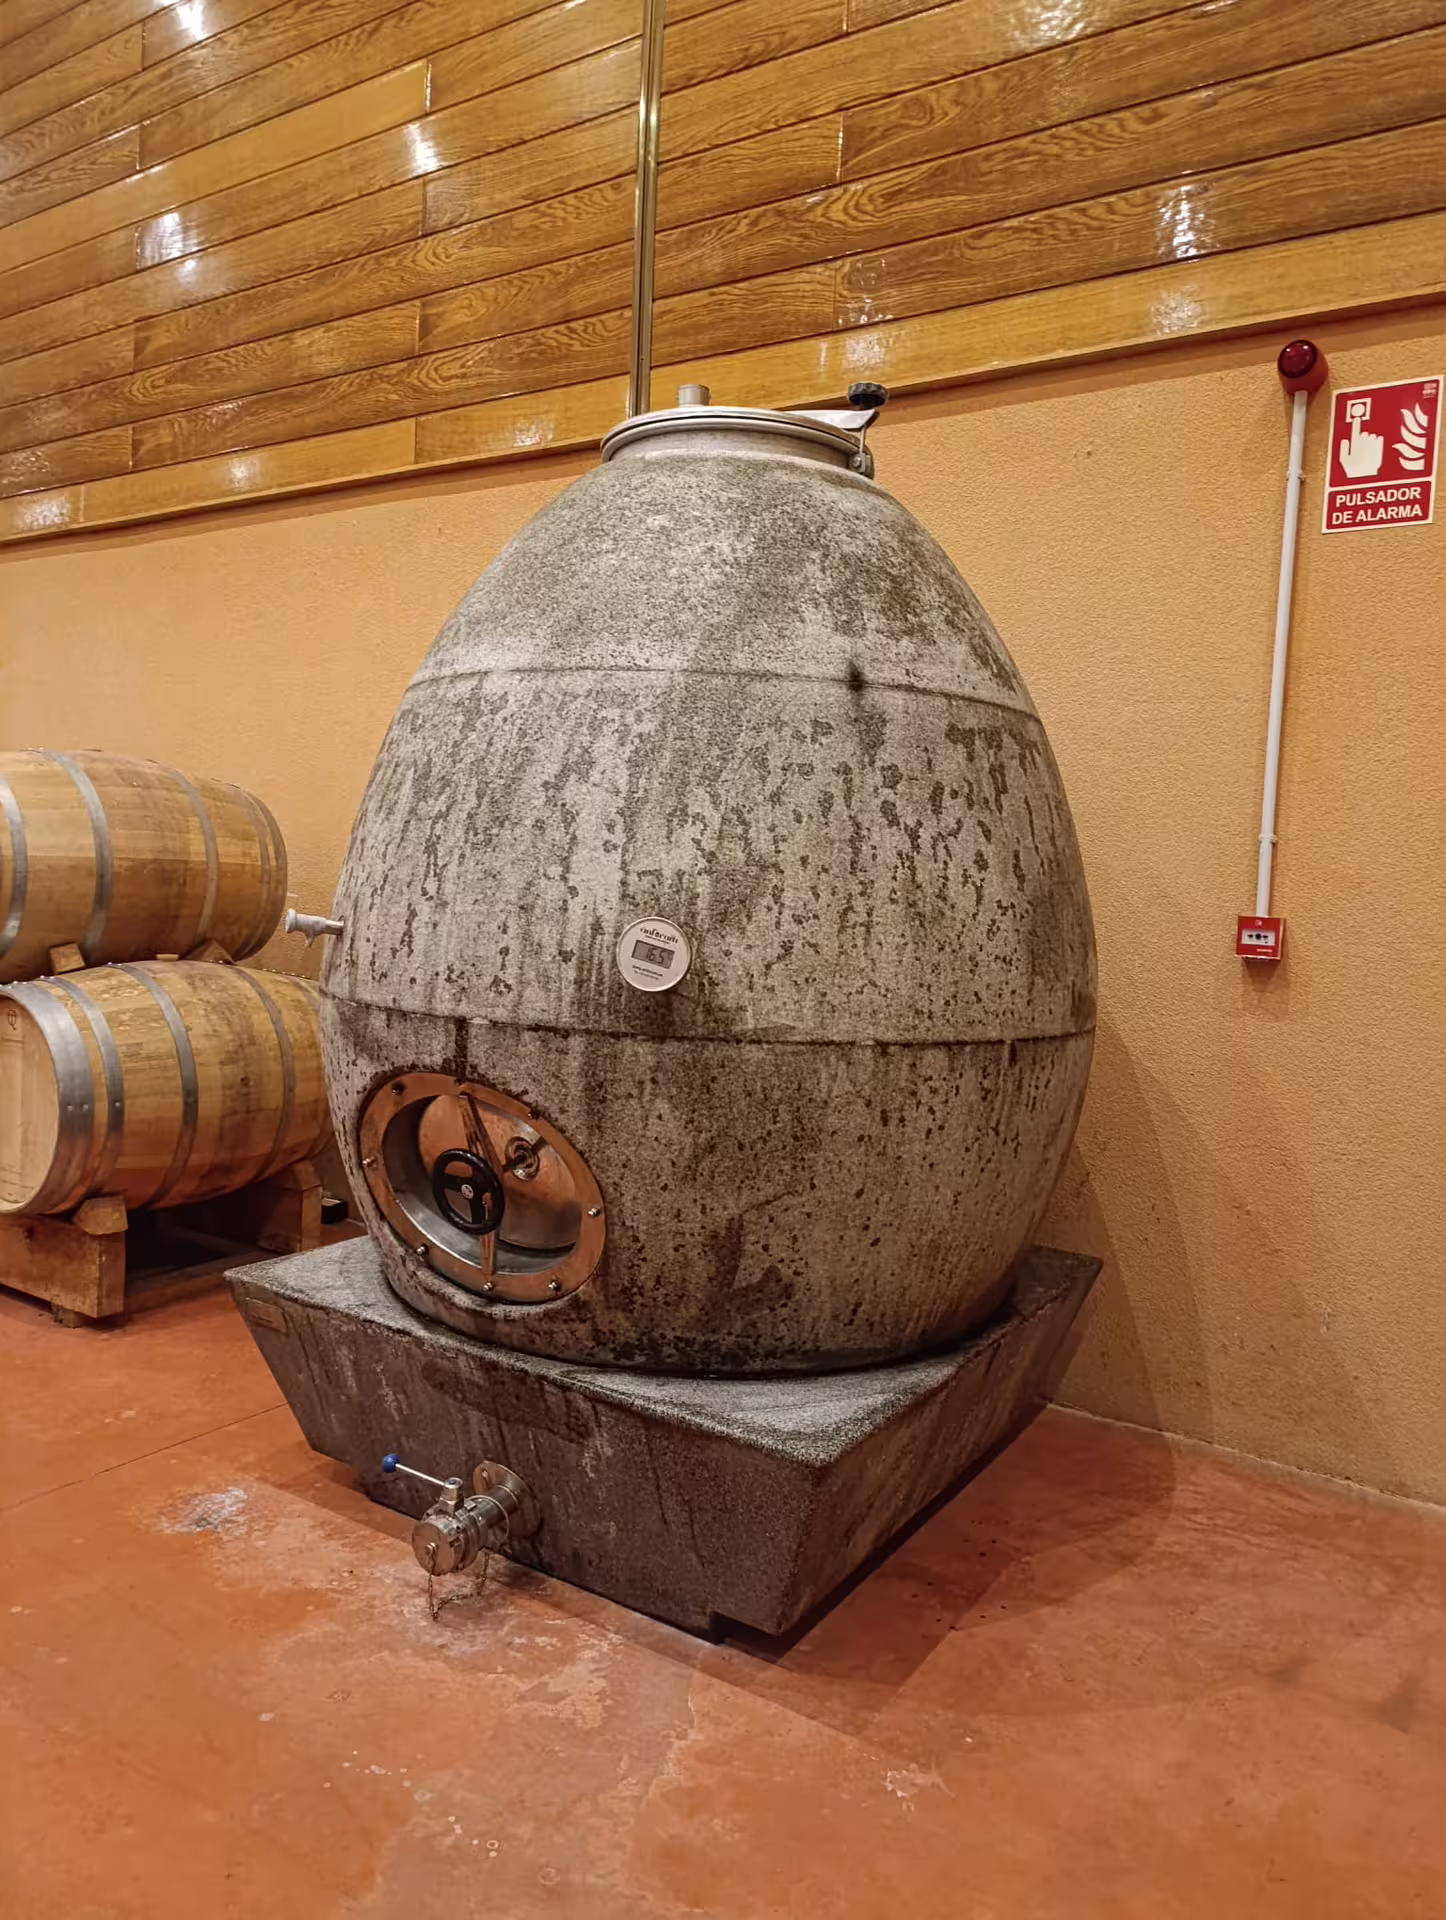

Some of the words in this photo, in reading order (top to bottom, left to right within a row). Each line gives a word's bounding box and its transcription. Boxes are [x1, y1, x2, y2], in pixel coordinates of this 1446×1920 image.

[1336, 487, 1421, 507] PULSADOR
[1332, 511, 1353, 525] DE
[1356, 504, 1423, 522] ALARMA
